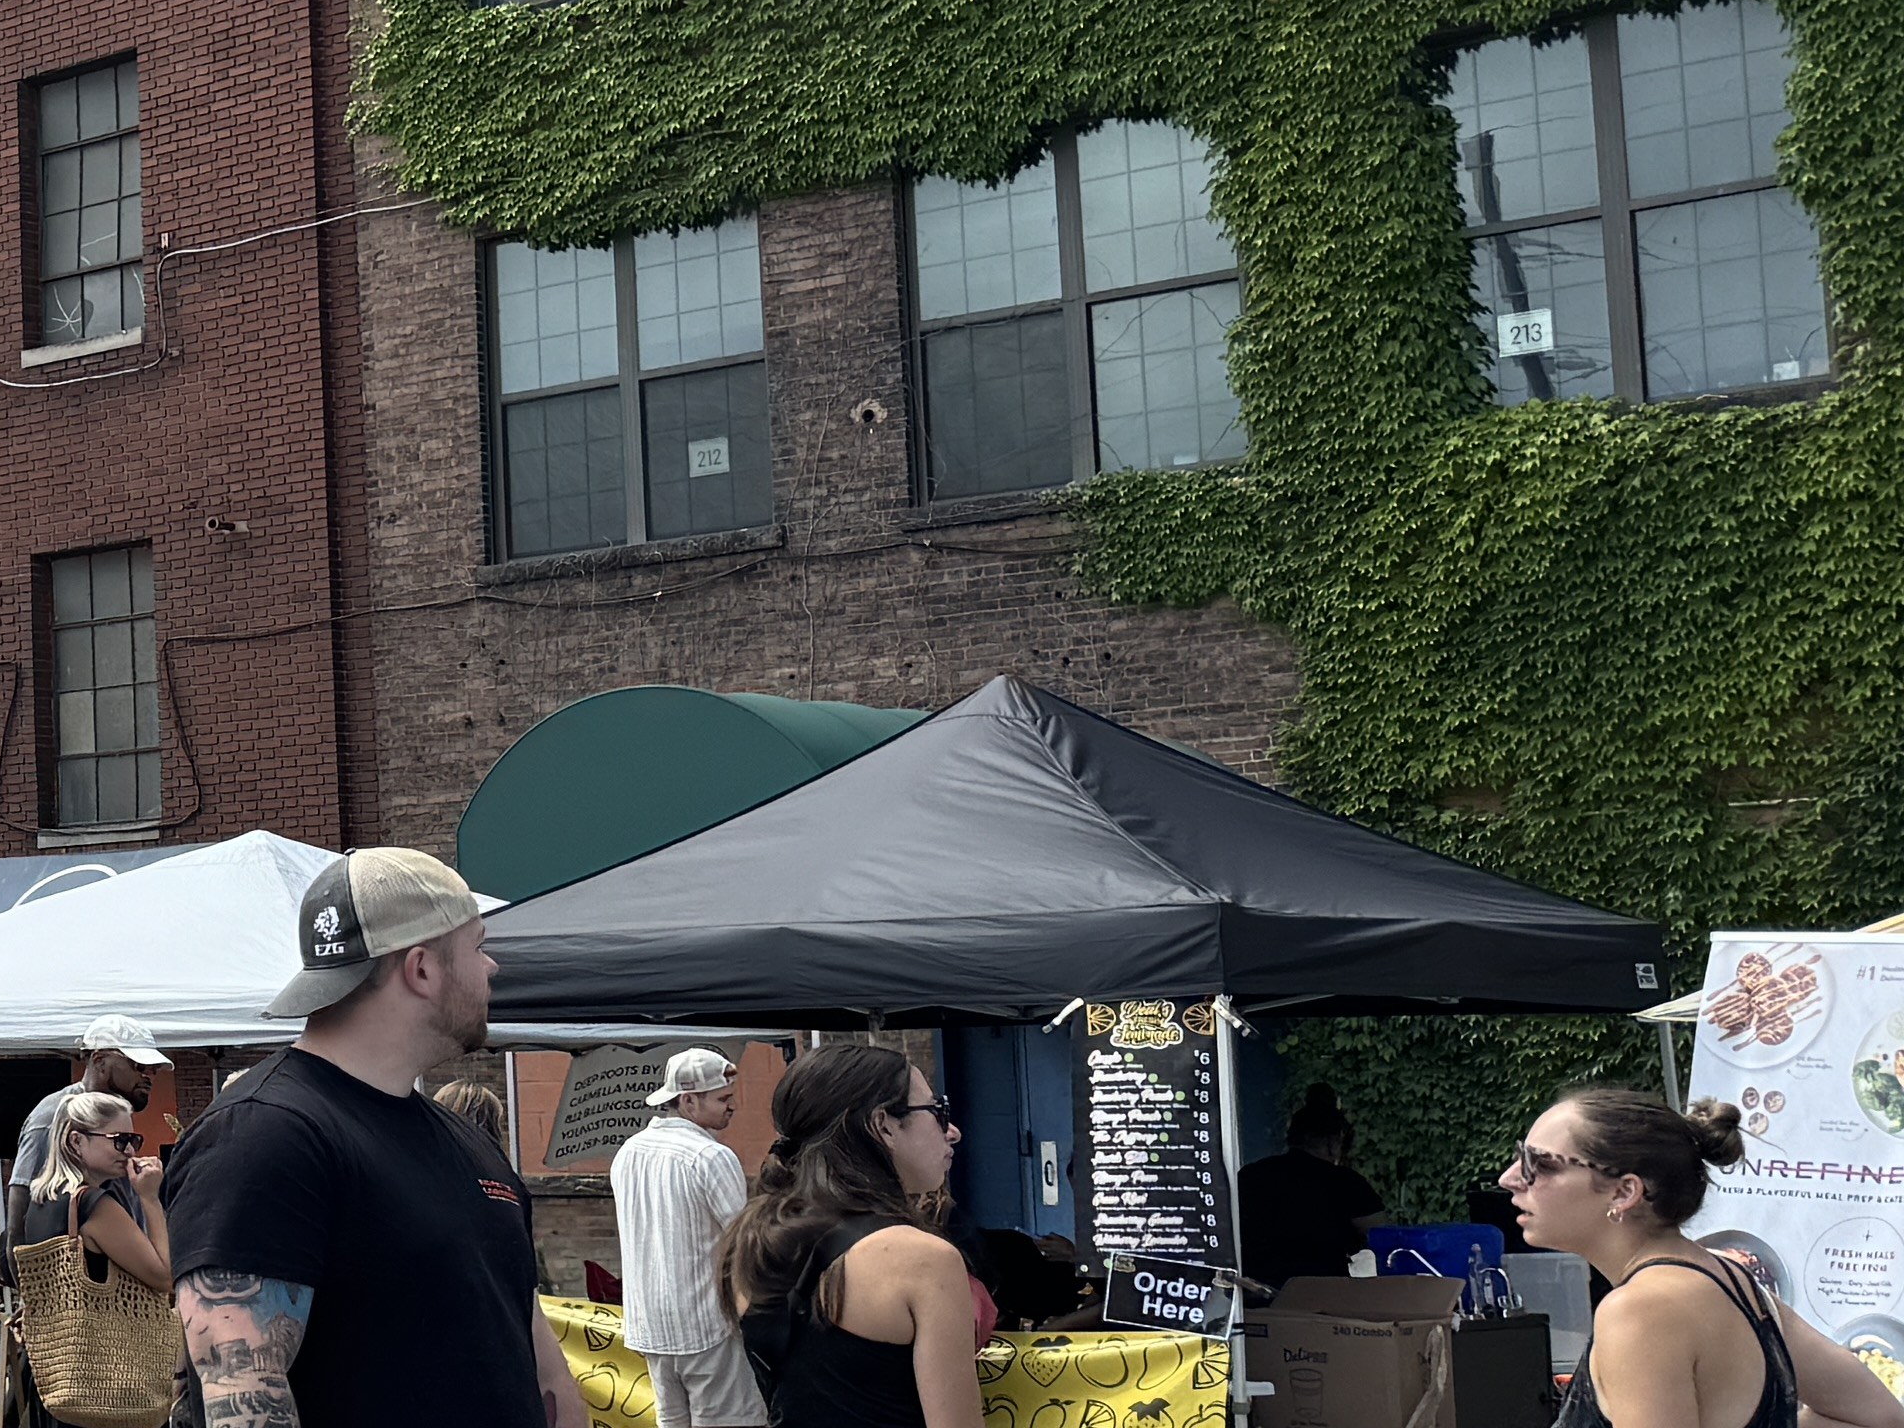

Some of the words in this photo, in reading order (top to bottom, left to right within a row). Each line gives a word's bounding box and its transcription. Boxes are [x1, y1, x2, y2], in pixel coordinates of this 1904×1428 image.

[1509, 322, 1543, 346] 213
[696, 448, 722, 468] 212
[641, 1065, 661, 1075] BY
[1755, 1188, 1812, 1199] FLAVORFUL
[1815, 1192, 1843, 1202] MEAL
[1847, 1194, 1874, 1203] PREP
[1824, 1247, 1863, 1259] FRESH
[1866, 1249, 1896, 1260] MEALS
[1830, 1261, 1858, 1272] FREE
[1133, 1271, 1212, 1302] Order
[1142, 1294, 1205, 1324] Here
